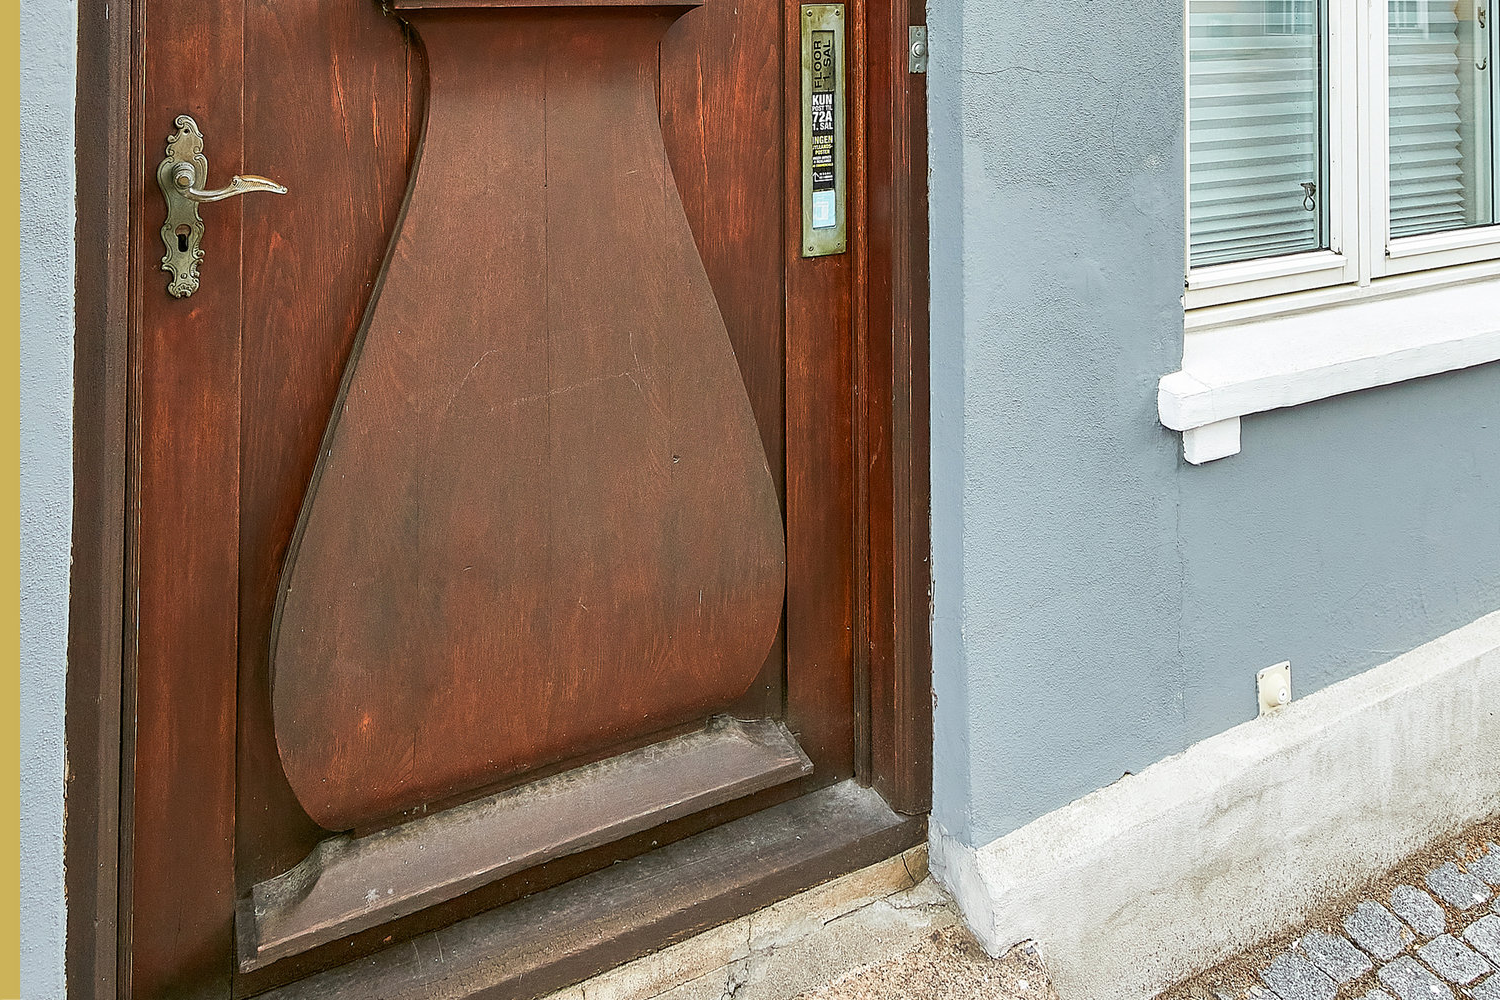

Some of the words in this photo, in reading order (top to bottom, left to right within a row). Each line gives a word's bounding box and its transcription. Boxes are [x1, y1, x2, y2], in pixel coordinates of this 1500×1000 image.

[823, 39, 831, 67] SAL
[813, 40, 822, 88] FLOOR
[812, 93, 833, 105] KUN
[812, 111, 833, 122] 72A
[812, 123, 819, 131] 1.
[820, 121, 833, 130] SAL
[812, 135, 833, 144] INGEN
